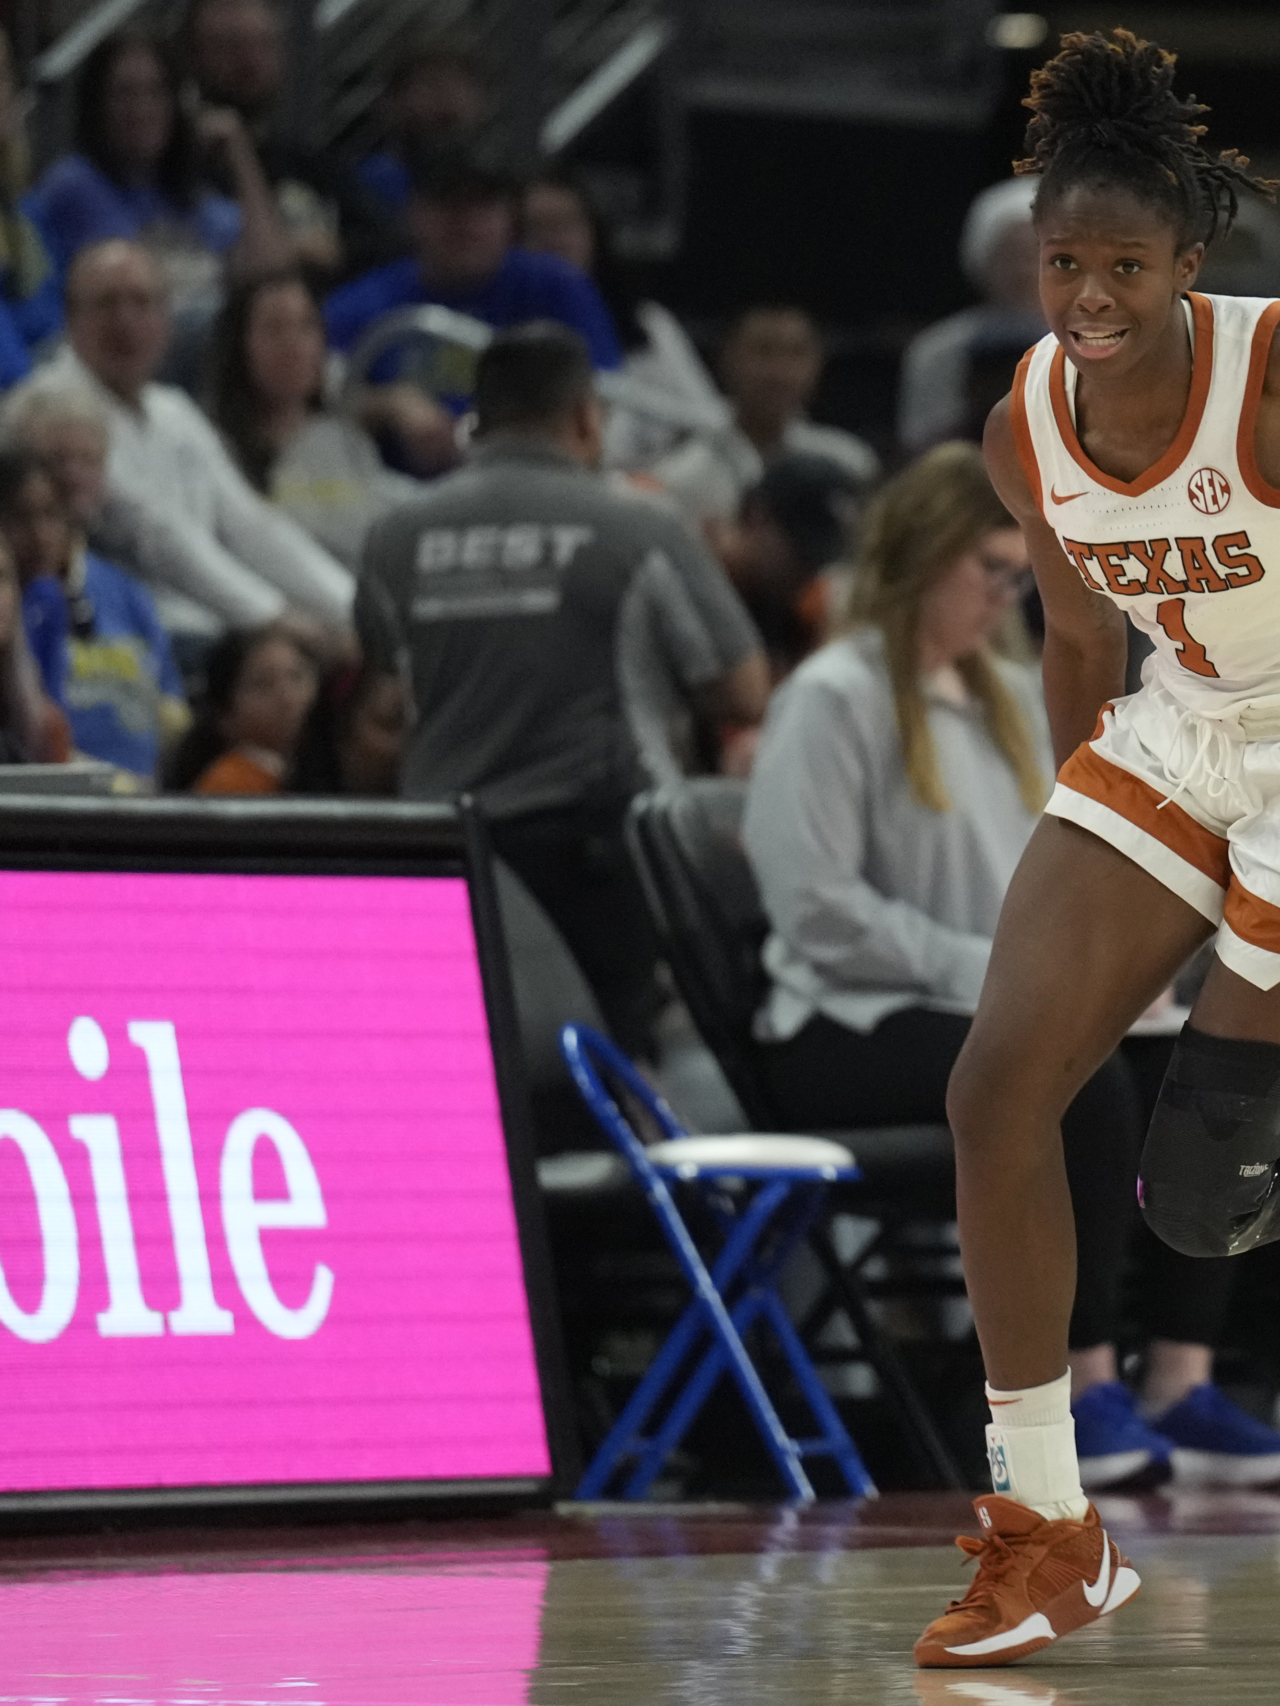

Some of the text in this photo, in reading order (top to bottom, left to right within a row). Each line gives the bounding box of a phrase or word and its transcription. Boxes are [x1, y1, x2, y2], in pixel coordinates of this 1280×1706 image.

[1190, 467, 1230, 514] SEC
[1062, 530, 1266, 596] TEXAS
[1156, 597, 1221, 679] 1
